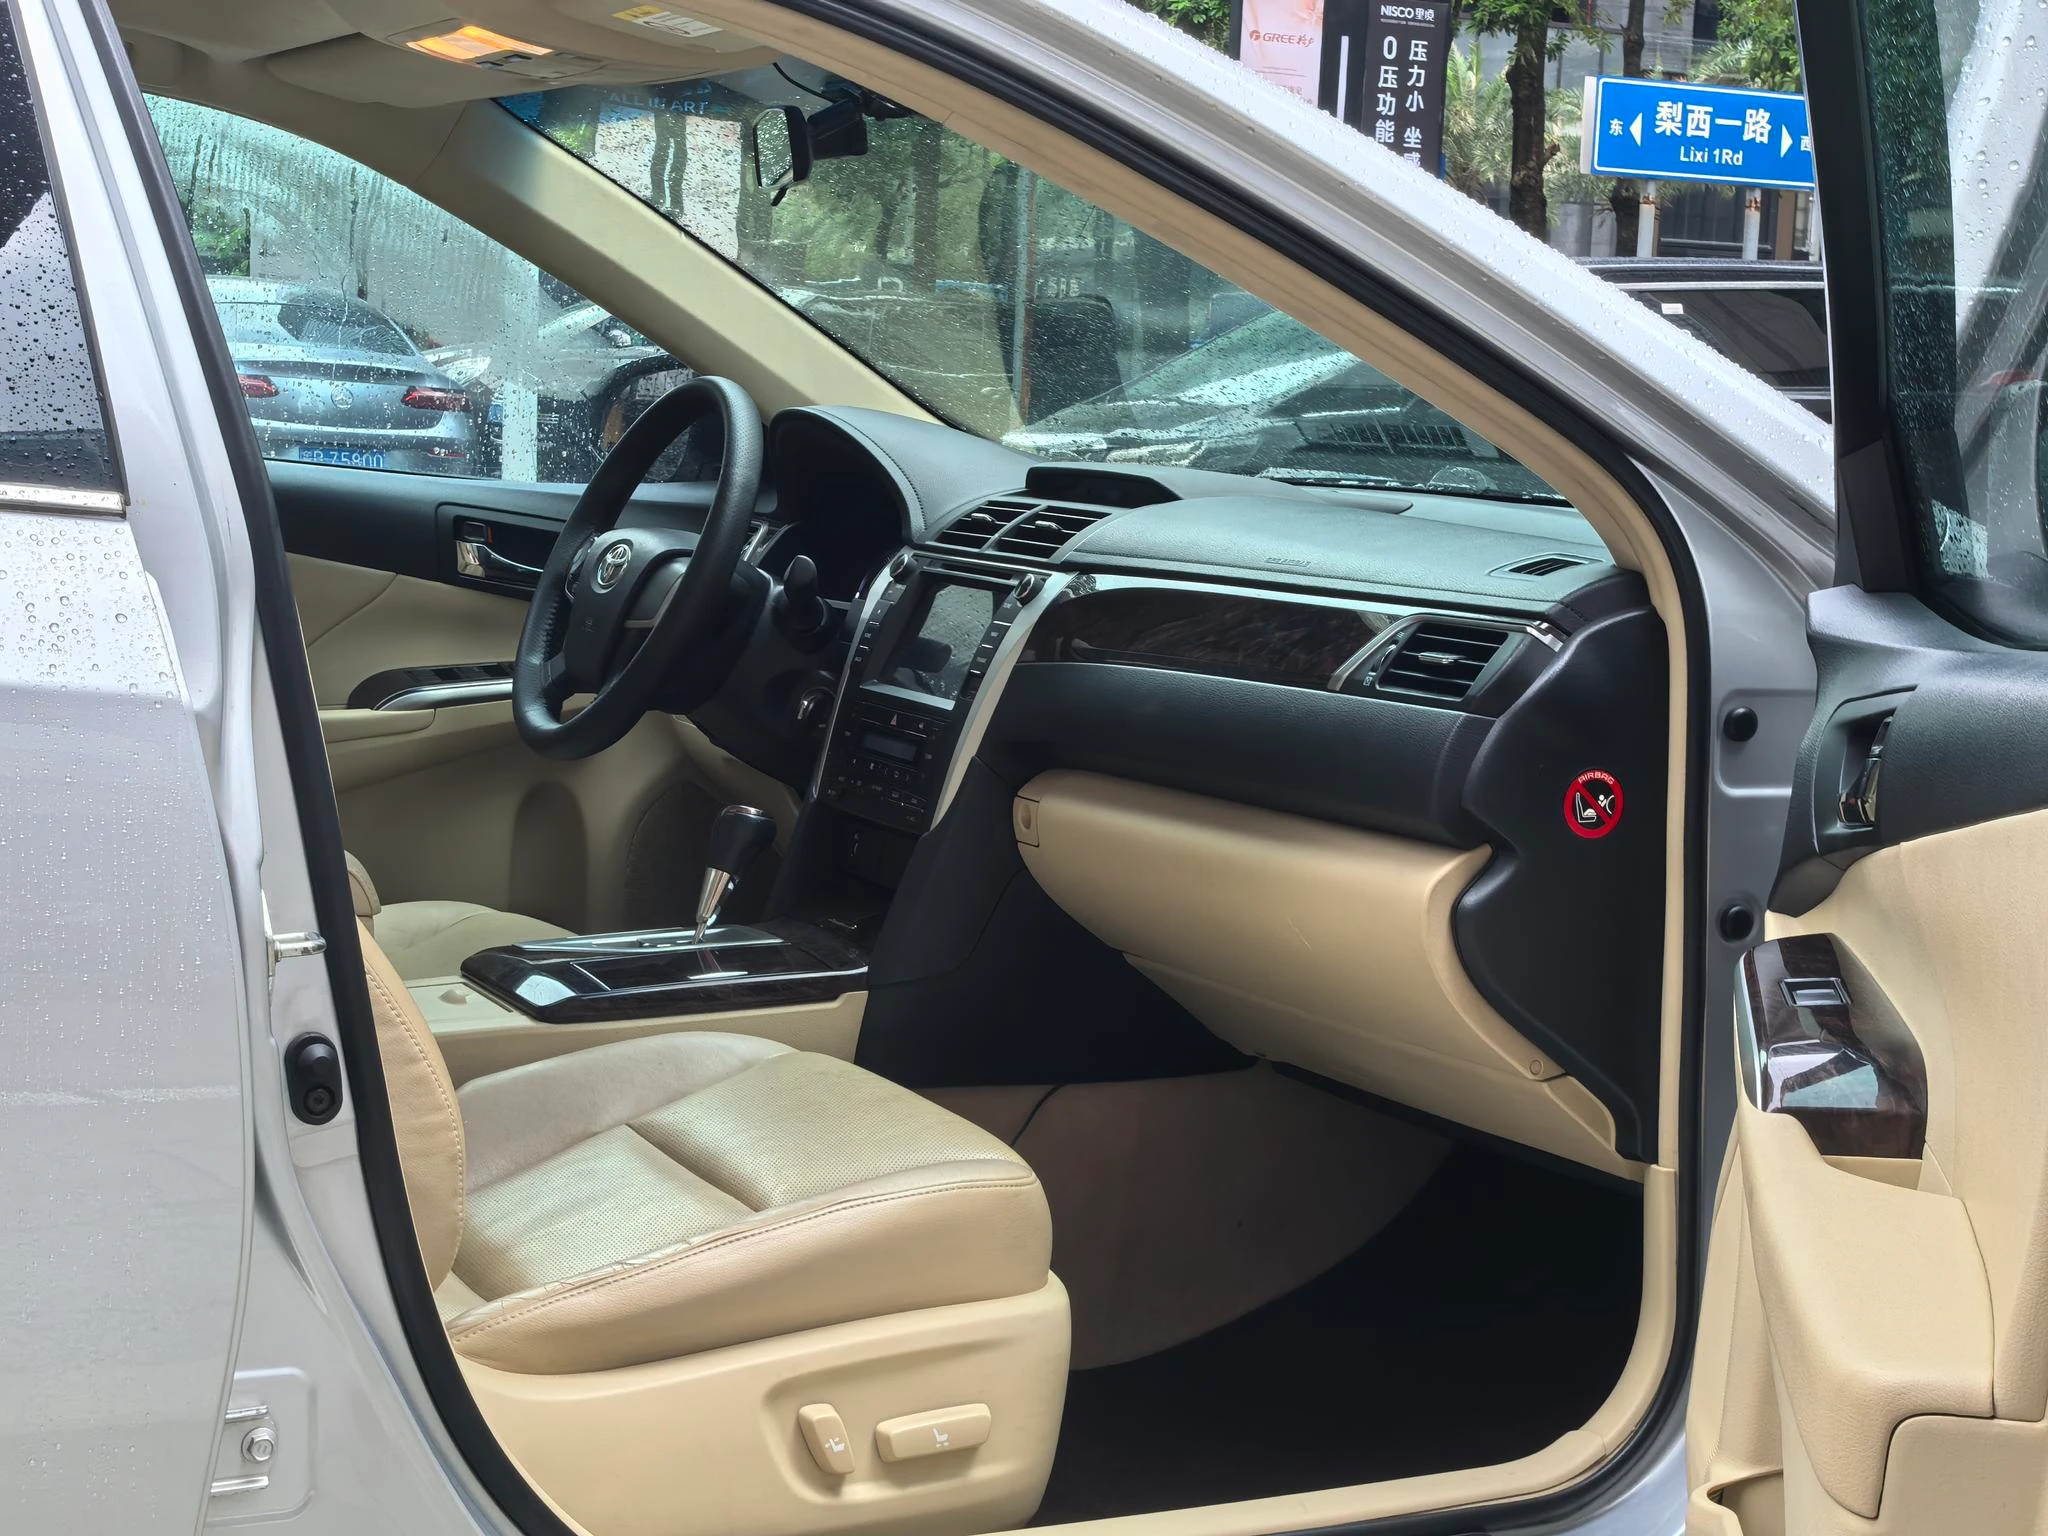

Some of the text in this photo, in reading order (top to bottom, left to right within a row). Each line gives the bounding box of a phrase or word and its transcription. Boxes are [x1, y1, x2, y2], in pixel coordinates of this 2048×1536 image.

[1380, 4, 1414, 19] NISCO
[1263, 32, 1297, 44] GREE
[671, 100, 708, 115] ART
[1609, 118, 1624, 136] 东
[1653, 101, 1772, 144] 梨西一路
[1680, 146, 1743, 166] Lixi 1Rd
[1578, 771, 1615, 785] AIRBAG
